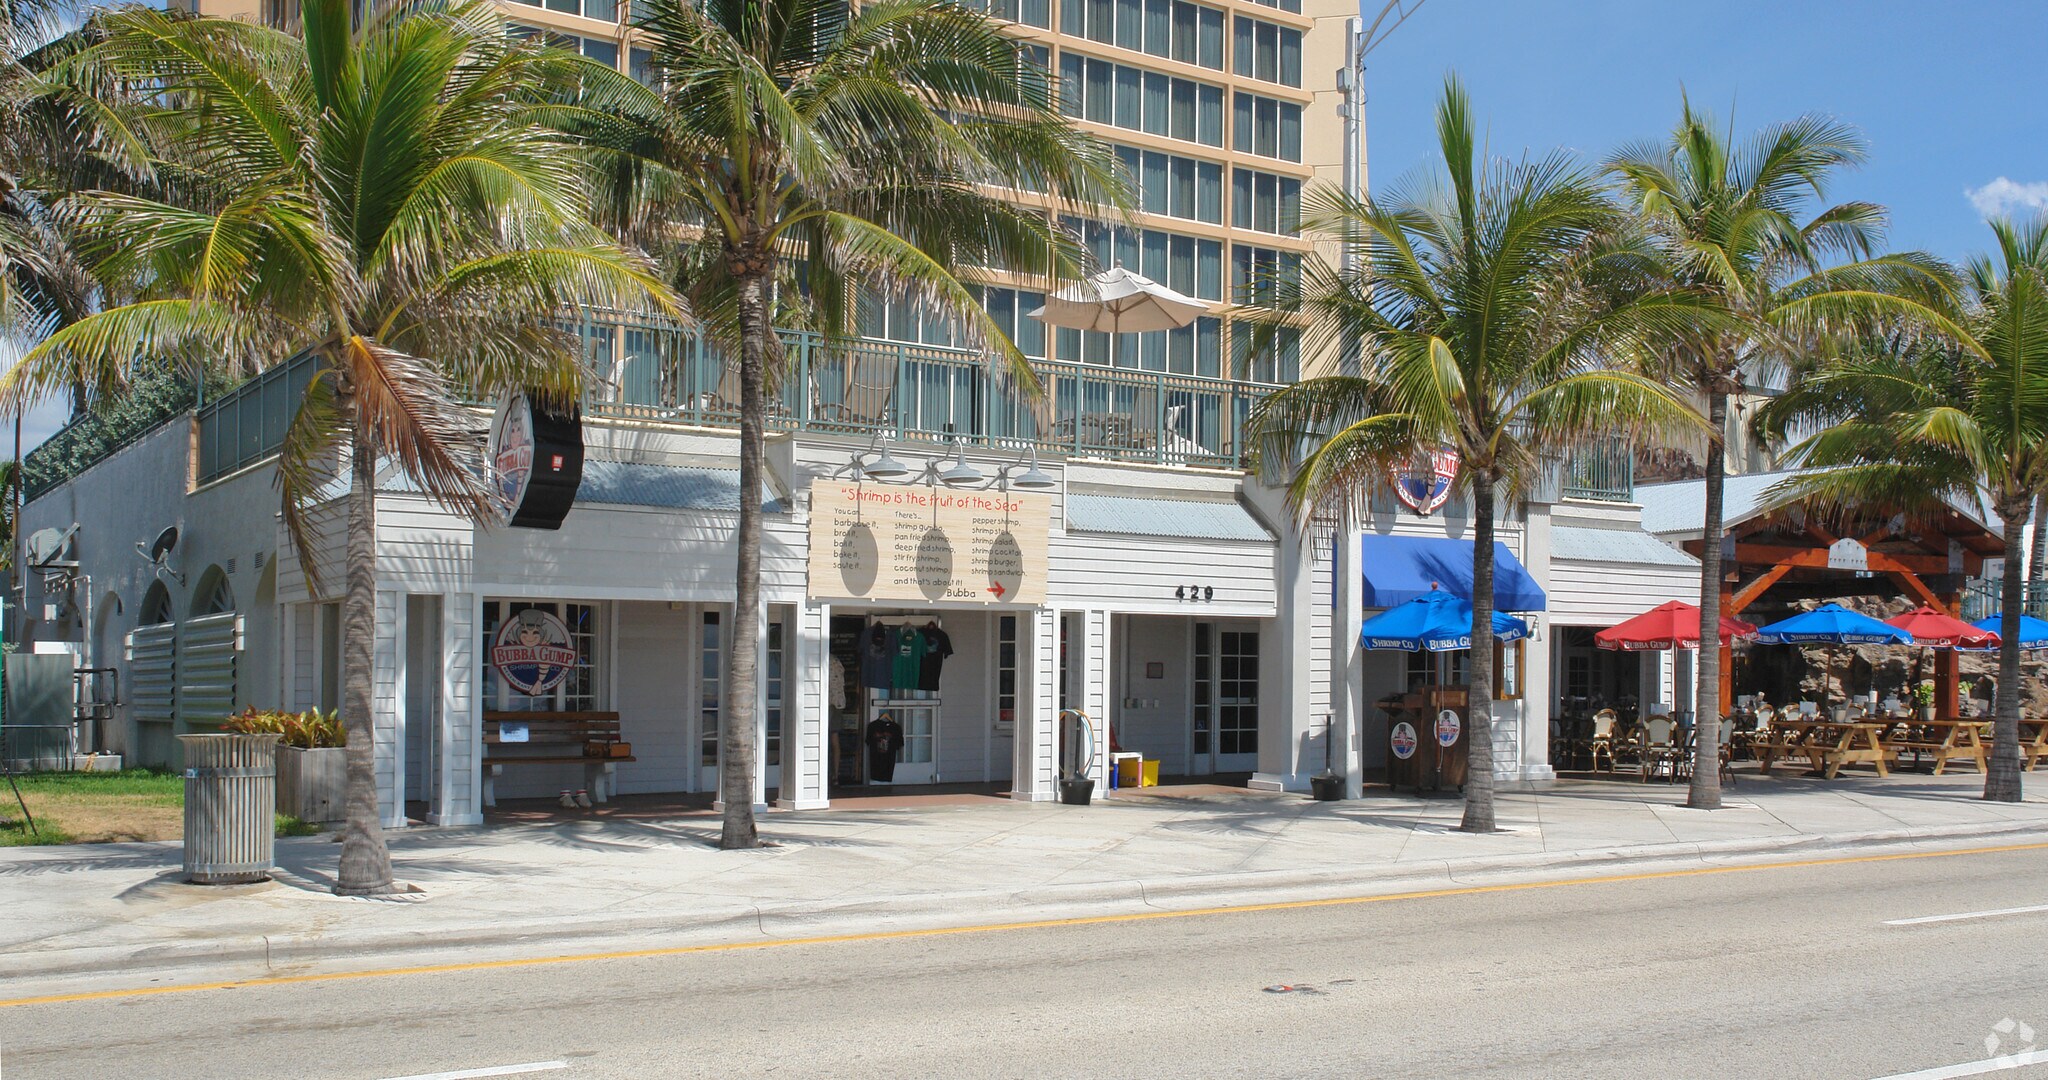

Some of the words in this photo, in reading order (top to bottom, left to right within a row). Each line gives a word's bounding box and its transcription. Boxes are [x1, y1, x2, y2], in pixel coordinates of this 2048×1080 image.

[842, 488, 891, 505] "Shrimp
[894, 492, 902, 503] is
[906, 492, 926, 506] the
[930, 494, 953, 507] fruit
[957, 496, 970, 508] of
[973, 496, 992, 510] the
[995, 498, 1024, 512] Sea"
[894, 522, 918, 530] shrimp
[910, 533, 926, 541] fried
[927, 535, 952, 543] shrimp,
[995, 538, 1014, 546] salad,
[895, 543, 913, 551] deep
[914, 544, 931, 552] fried
[931, 545, 956, 554] shrimp,
[972, 547, 993, 555] shrimp
[834, 550, 852, 559] bake
[906, 554, 916, 562] fry
[917, 555, 942, 564] shrimp,
[994, 558, 1018, 567] burger,
[926, 566, 950, 574] shrimp,
[972, 567, 993, 575] shrimp
[910, 578, 930, 586] that's
[932, 578, 954, 586] about
[947, 588, 976, 598] Bubba
[1175, 585, 1213, 600] 429
[1429, 639, 1457, 650] BUBBA
[1460, 636, 1472, 646] GU
[1624, 640, 1649, 649] BUBBA
[1650, 641, 1669, 649] GUMP
[496, 648, 537, 663] BUBBA
[539, 646, 574, 664] GUMP
